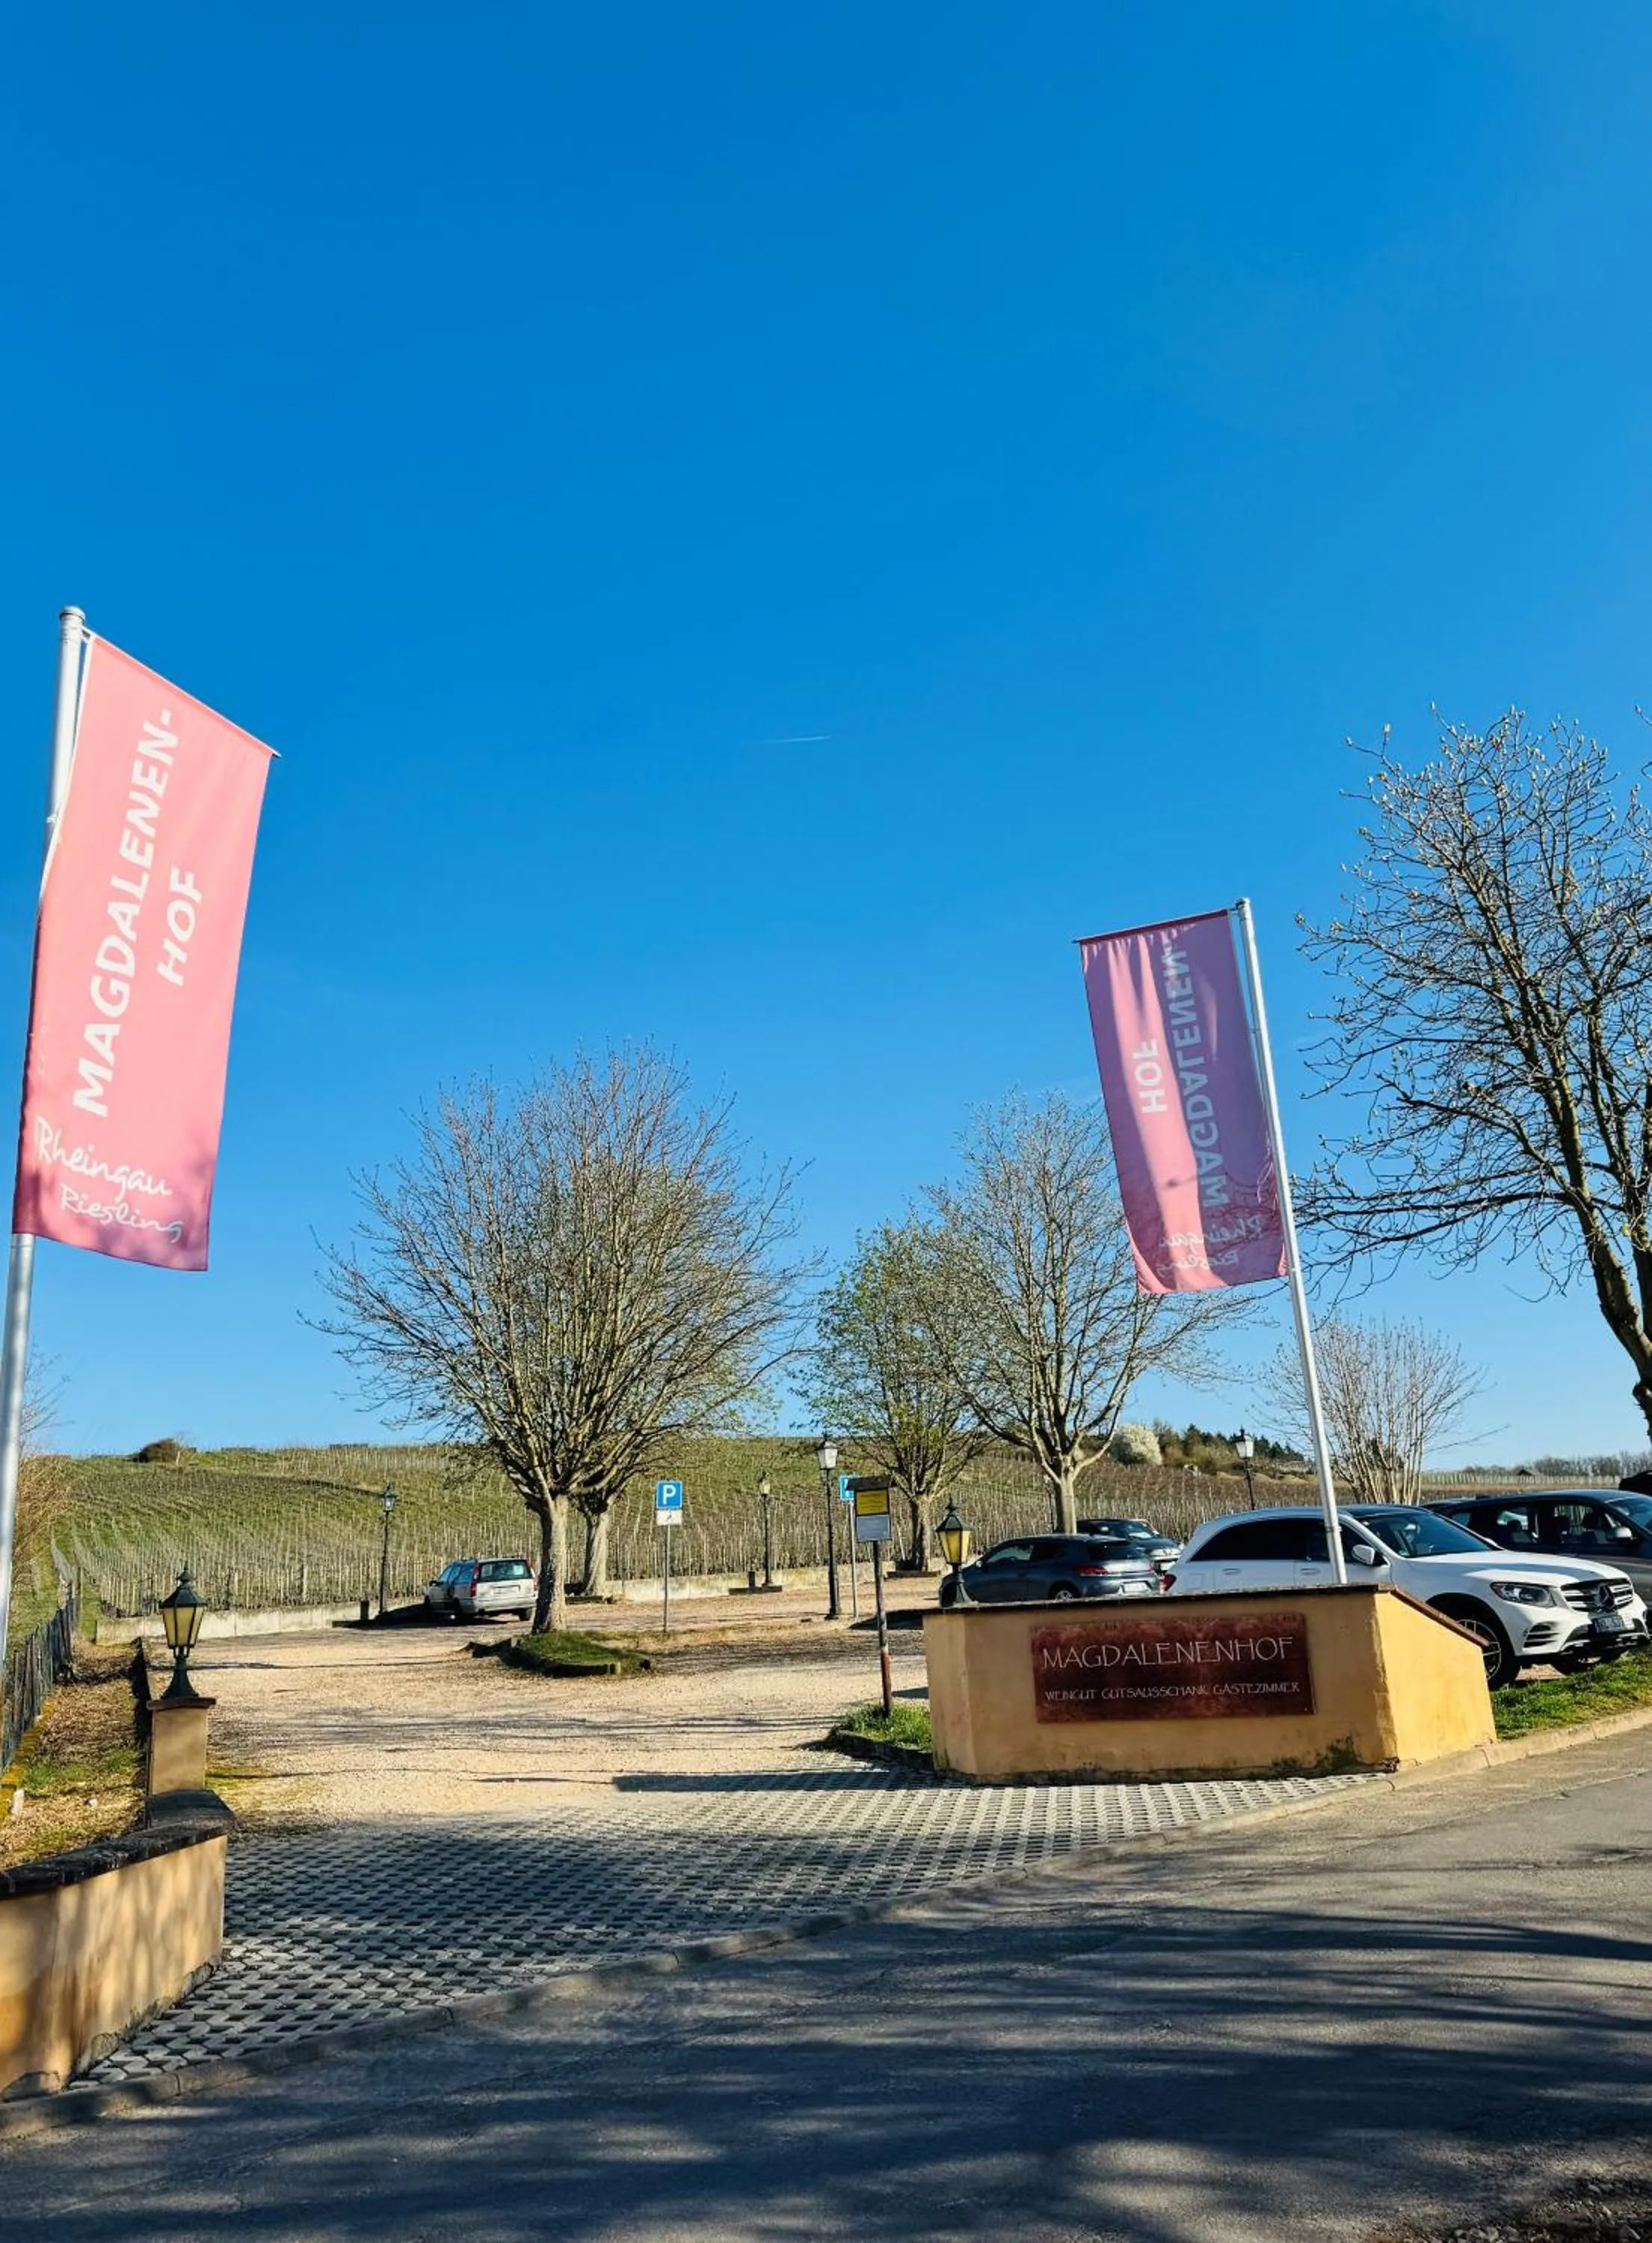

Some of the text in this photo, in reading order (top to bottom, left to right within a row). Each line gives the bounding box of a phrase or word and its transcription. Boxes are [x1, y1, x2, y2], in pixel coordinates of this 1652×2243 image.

[73, 707, 180, 1118] MAGDALENEN-
[157, 863, 203, 987] HOF
[34, 1116, 173, 1202] Rheingau
[60, 1183, 184, 1243] Riesling
[663, 1484, 676, 1504] P
[1043, 1637, 1294, 1670] MAGDALENENHOF
[1044, 1689, 1096, 1702] WEINGUT
